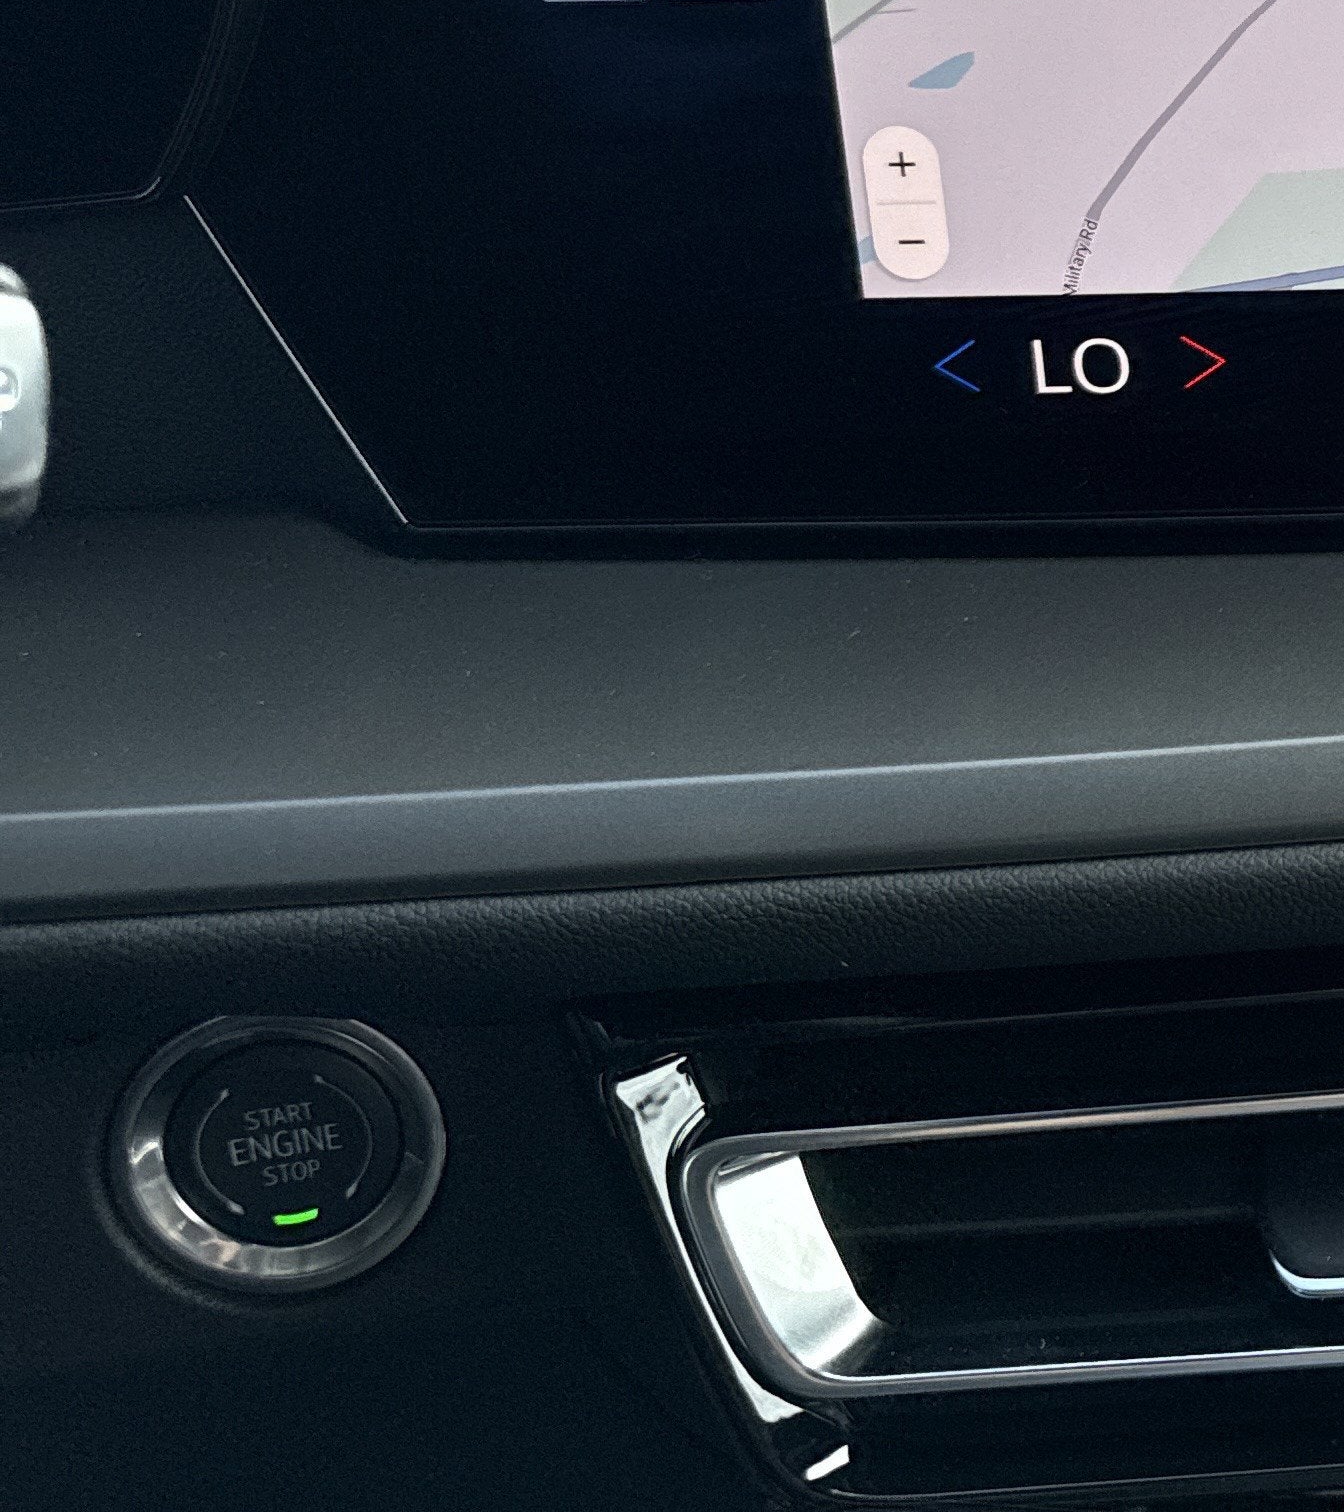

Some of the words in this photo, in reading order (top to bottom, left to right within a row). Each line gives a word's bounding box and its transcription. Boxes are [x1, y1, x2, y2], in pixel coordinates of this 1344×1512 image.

[1061, 243, 1091, 295] Military
[1080, 219, 1098, 241] Rd
[1030, 338, 1130, 395] LO
[243, 1101, 314, 1130] START
[228, 1123, 343, 1167] ENGINE
[261, 1159, 321, 1187] STOP
